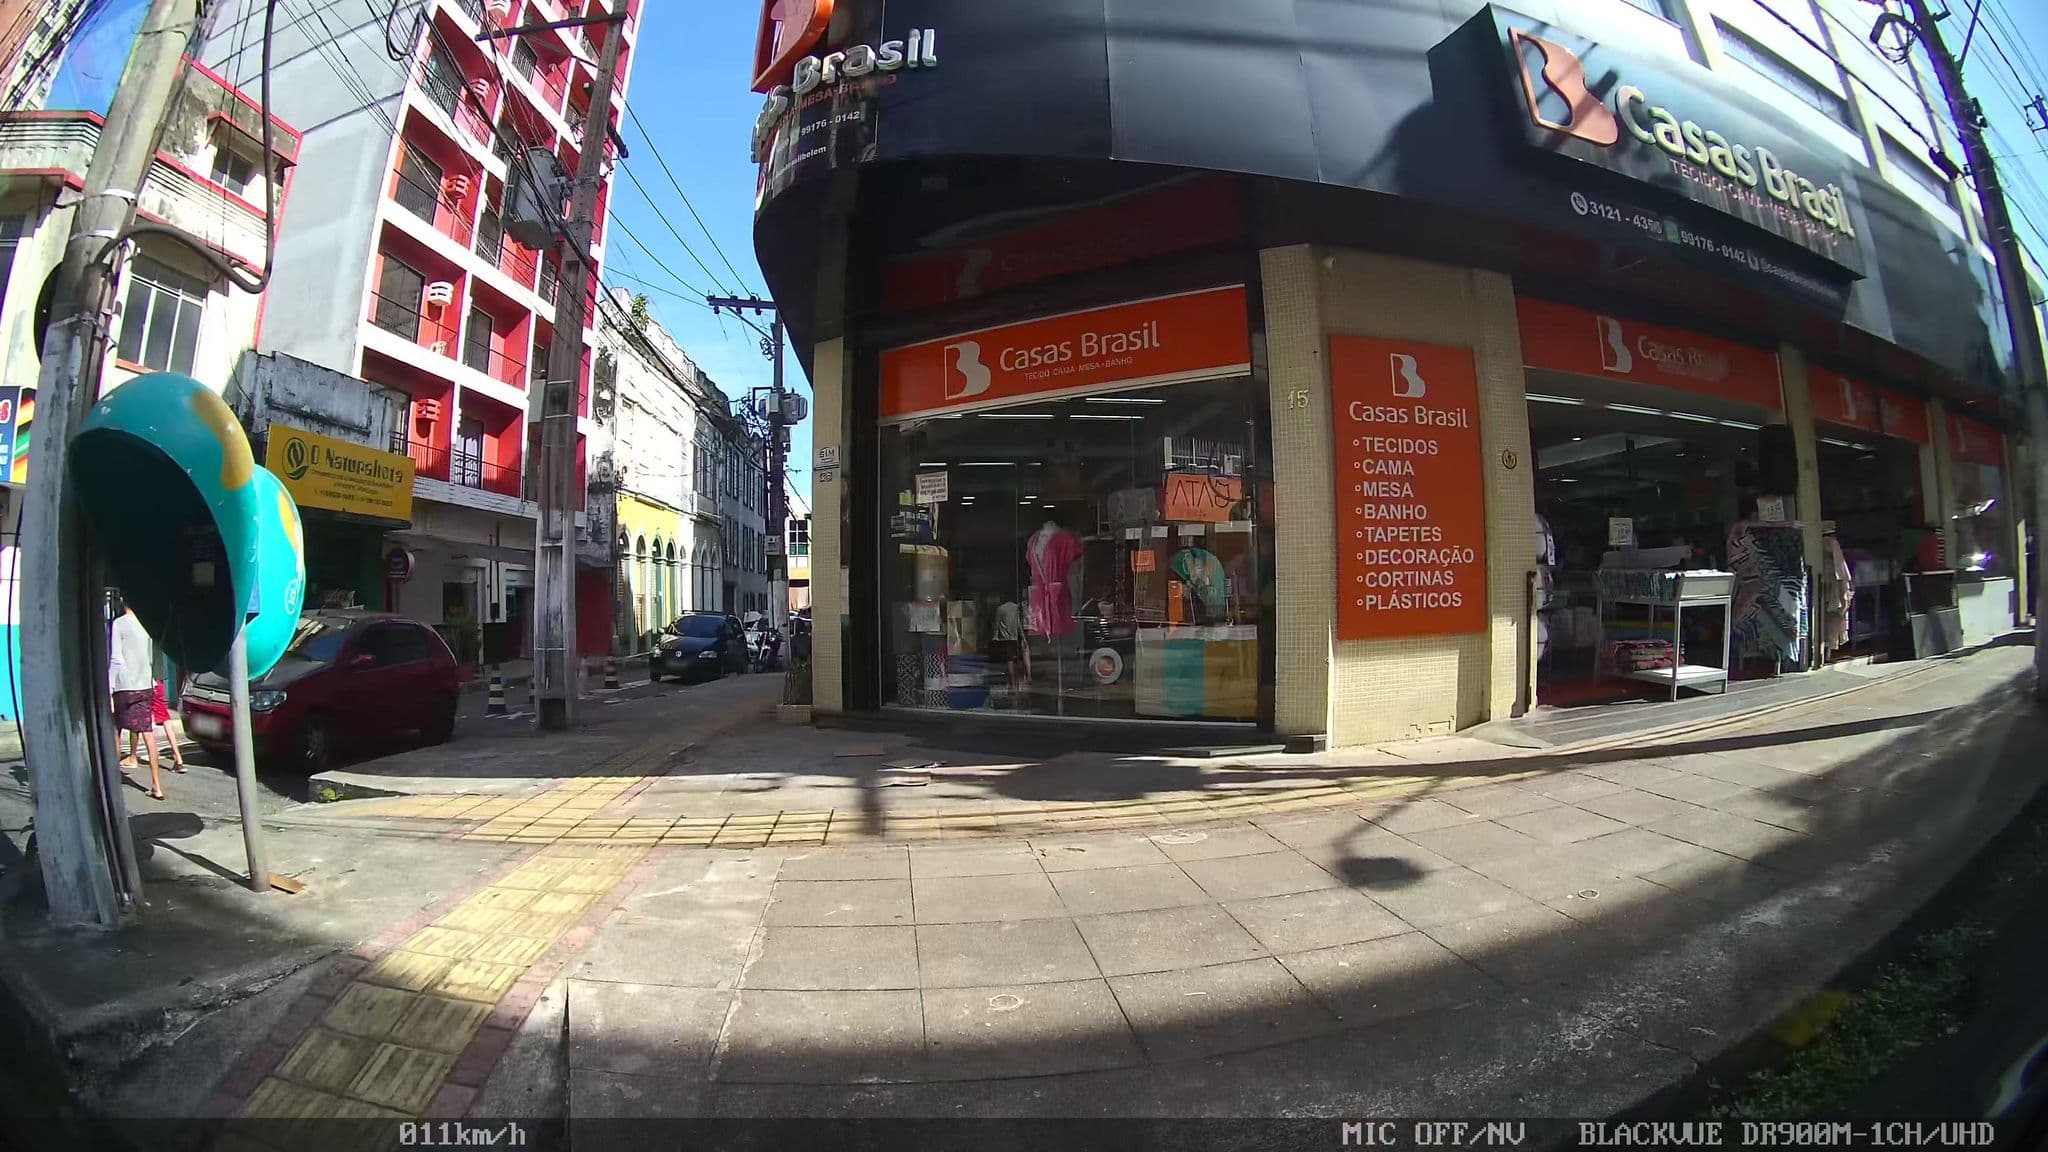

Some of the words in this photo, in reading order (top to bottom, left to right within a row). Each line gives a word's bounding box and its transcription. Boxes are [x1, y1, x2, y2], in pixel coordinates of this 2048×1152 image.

[793, 28, 937, 94] Brasil
[801, 119, 827, 136] 99176
[835, 111, 860, 124] 0142
[1616, 85, 1758, 188] Casas
[1755, 146, 1855, 238] Brasil
[1590, 201, 1621, 222] 3121
[1680, 230, 1714, 253] 99176
[1722, 245, 1746, 263] 0142
[1000, 340, 1072, 372] Casas
[1081, 320, 1160, 358] Brasil
[1106, 357, 1133, 368] BANHO
[1349, 401, 1408, 423] Casas
[1414, 405, 1469, 428] Brasil
[1362, 437, 1438, 455] TECIDOS
[1362, 459, 1415, 476] CAMA
[1363, 481, 1414, 498] MESA
[1364, 504, 1427, 520] BANHO
[1364, 526, 1442, 543] TAPETES
[1365, 545, 1474, 567] DECORAÇÃO
[1365, 570, 1454, 588] CORTINAS
[1365, 590, 1462, 611] PLÁSTICOS
